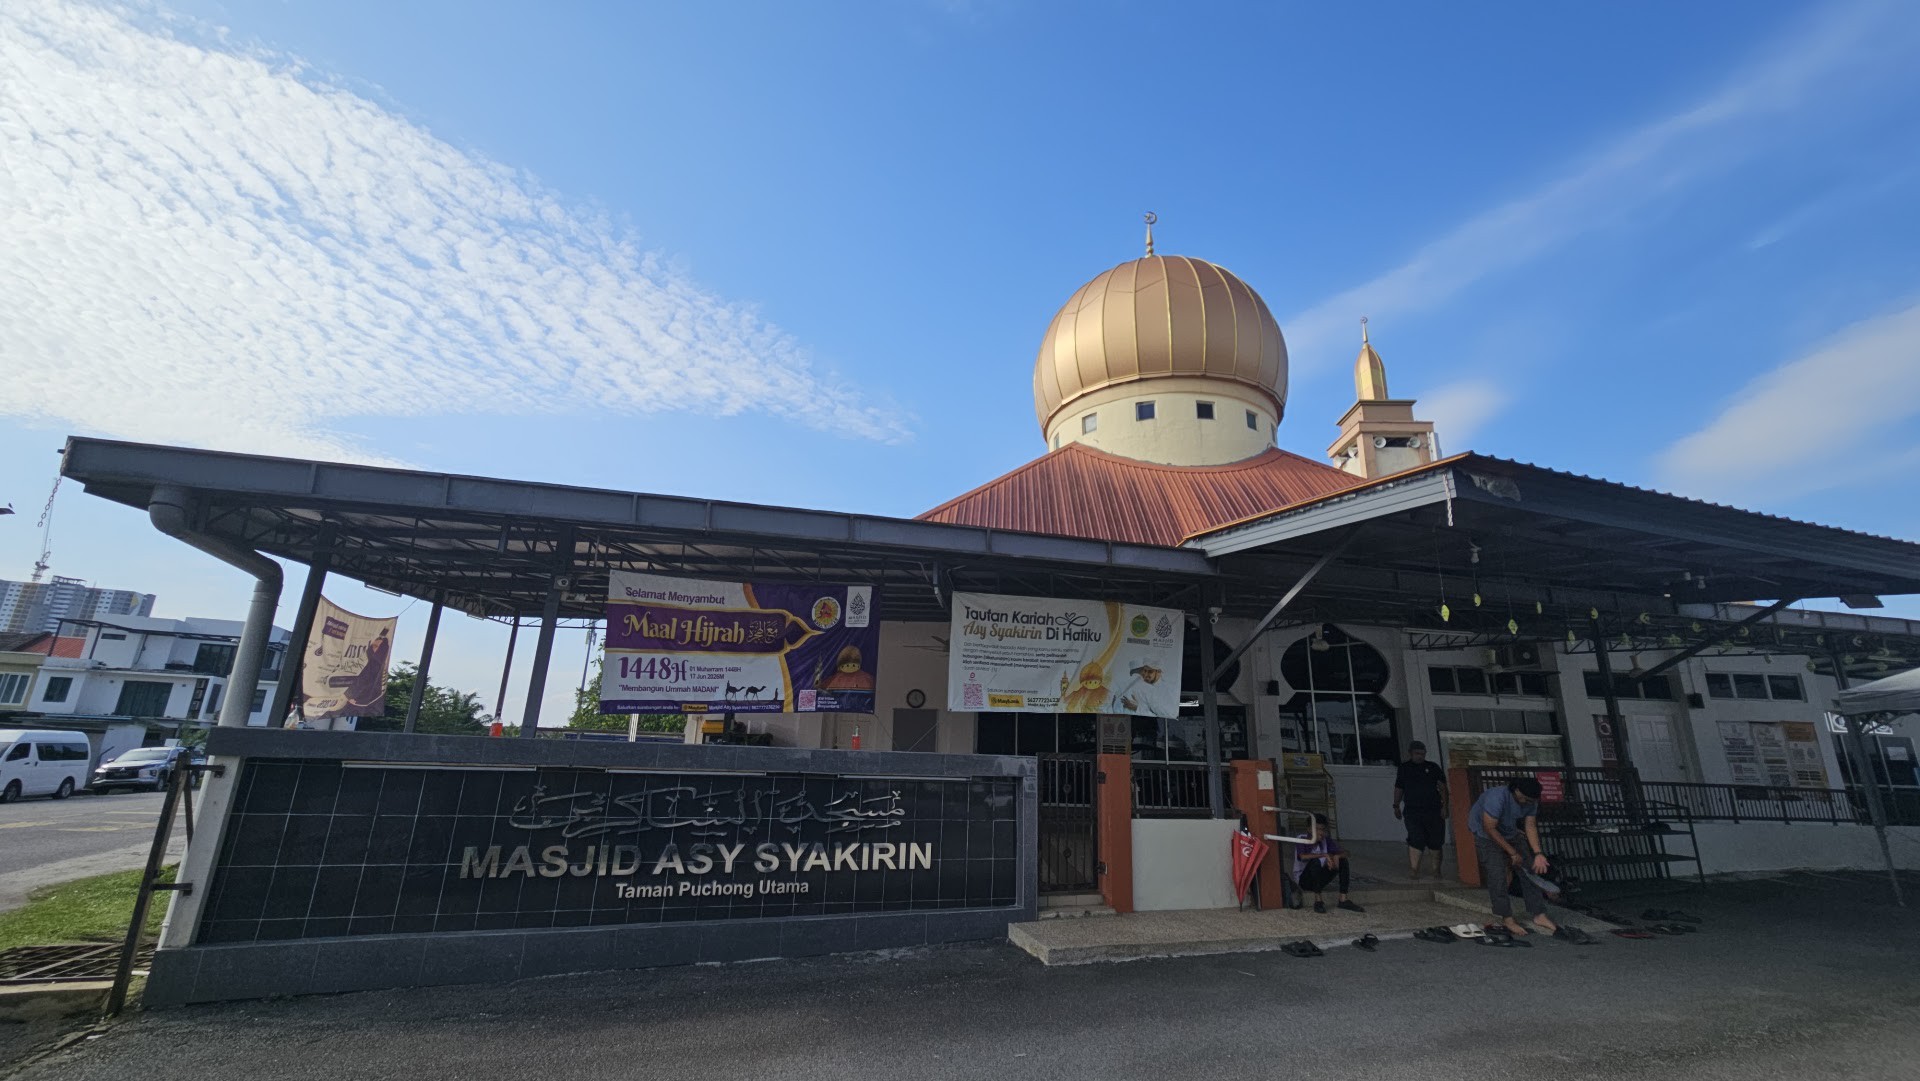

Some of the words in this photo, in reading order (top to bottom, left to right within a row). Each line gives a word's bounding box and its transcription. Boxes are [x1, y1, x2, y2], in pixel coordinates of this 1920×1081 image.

[625, 587, 666, 600] Selamat
[668, 591, 725, 605] Menyambut
[964, 606, 1008, 623] Tautan
[1011, 611, 1054, 625] Kariah
[622, 611, 677, 640] Maal
[678, 615, 745, 648] Hijrah
[963, 621, 987, 640] Asy
[989, 623, 1042, 641] Syakirin
[1046, 627, 1059, 640] Di
[1062, 628, 1102, 642] Hatiku
[618, 656, 689, 683] 1448H
[665, 685, 691, 693] Ummah
[459, 845, 642, 879] MASJID
[651, 842, 746, 875] ASY
[753, 842, 932, 873] SYAKIRIN
[615, 882, 674, 899] Taman
[678, 880, 754, 898] Puchong
[758, 879, 809, 894] Utama
